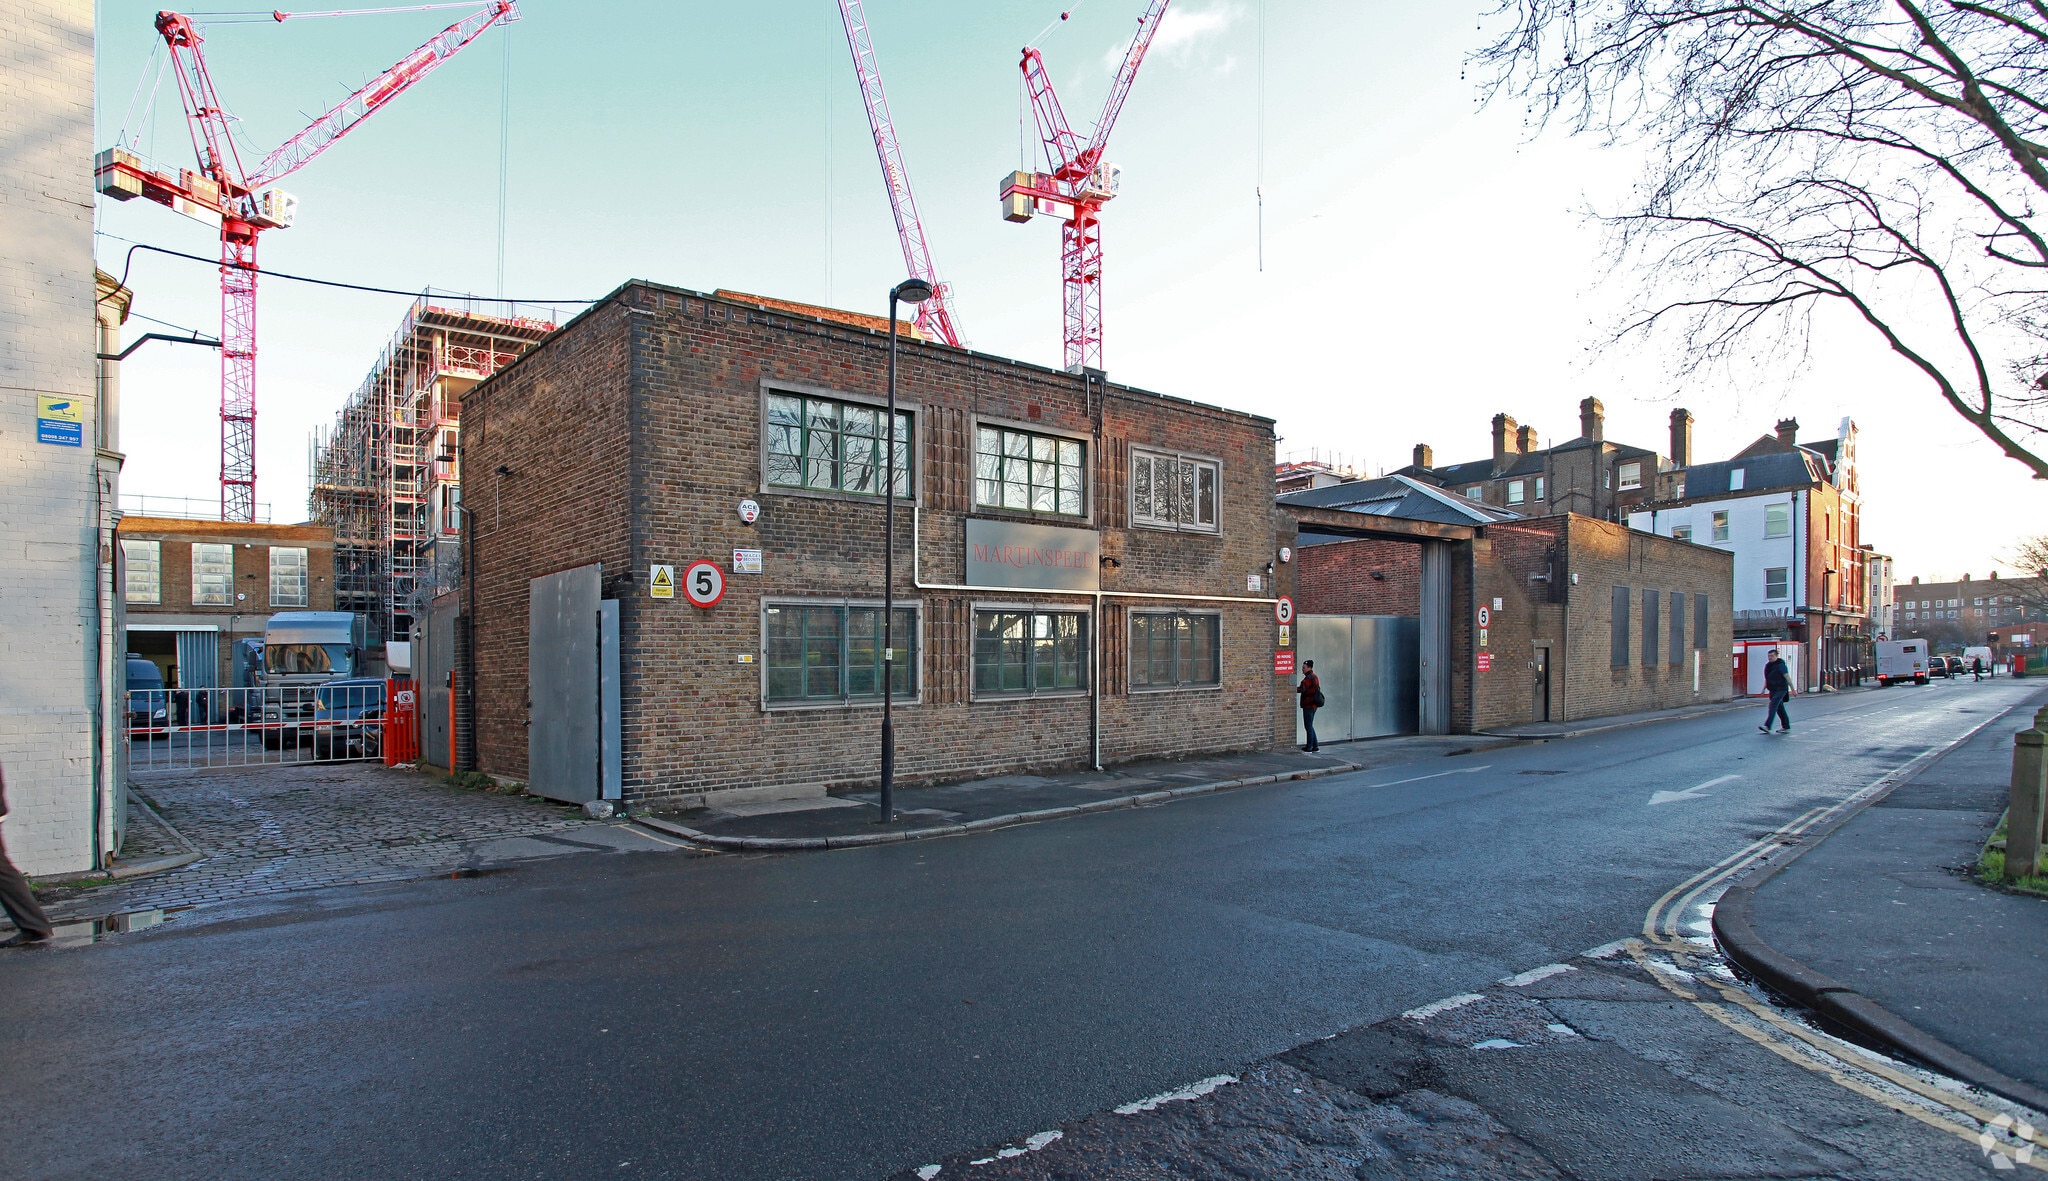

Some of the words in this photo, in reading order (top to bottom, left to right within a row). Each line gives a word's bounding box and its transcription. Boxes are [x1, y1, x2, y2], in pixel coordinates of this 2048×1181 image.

[973, 543, 1095, 569] MARTINSPEED
[696, 571, 713, 596] 5
[1281, 603, 1288, 618] 5
[1481, 611, 1487, 623] 5
